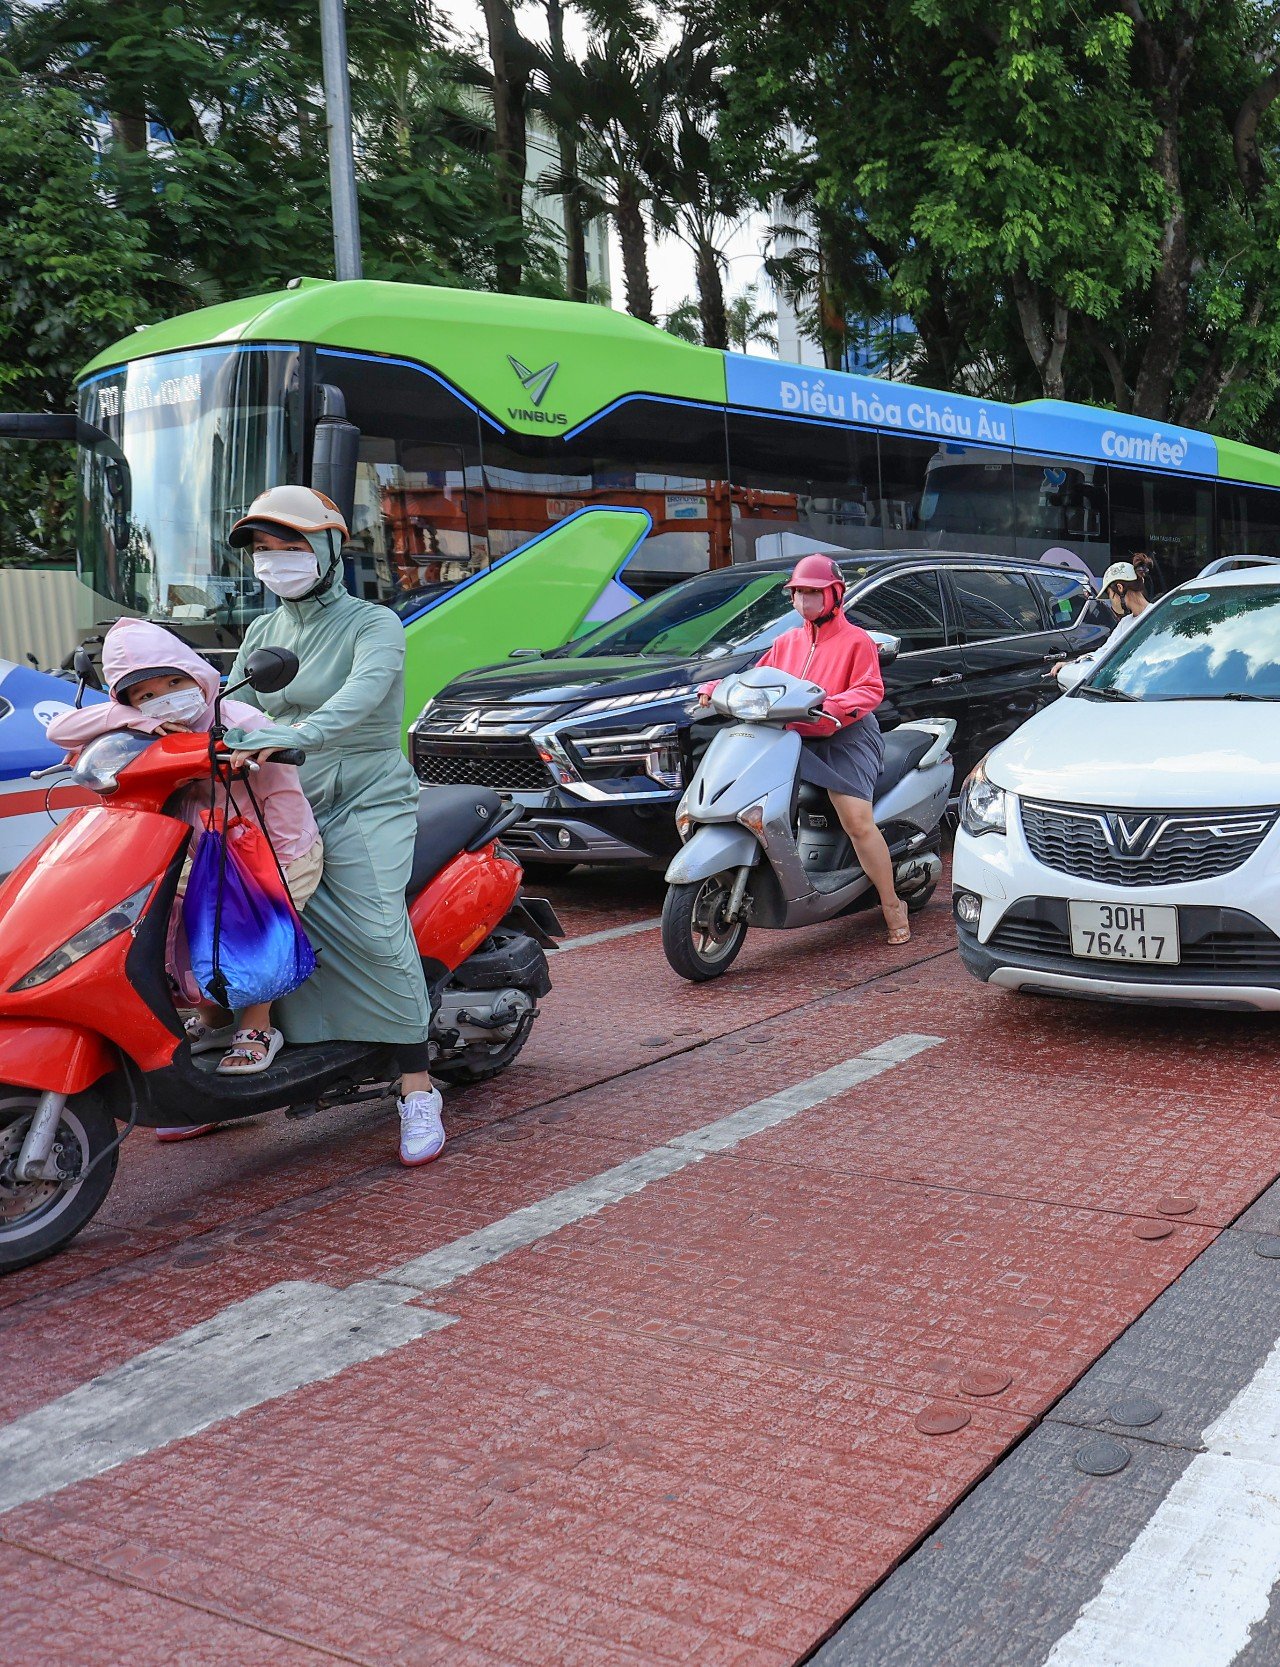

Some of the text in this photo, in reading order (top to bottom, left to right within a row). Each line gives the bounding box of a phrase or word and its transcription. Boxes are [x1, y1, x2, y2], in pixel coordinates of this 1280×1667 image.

[507, 408, 568, 425] VINBUS
[780, 379, 1006, 441] Điều hòa Châu Âu
[1100, 906, 1144, 931] 30H
[1082, 931, 1165, 959] 764.17
